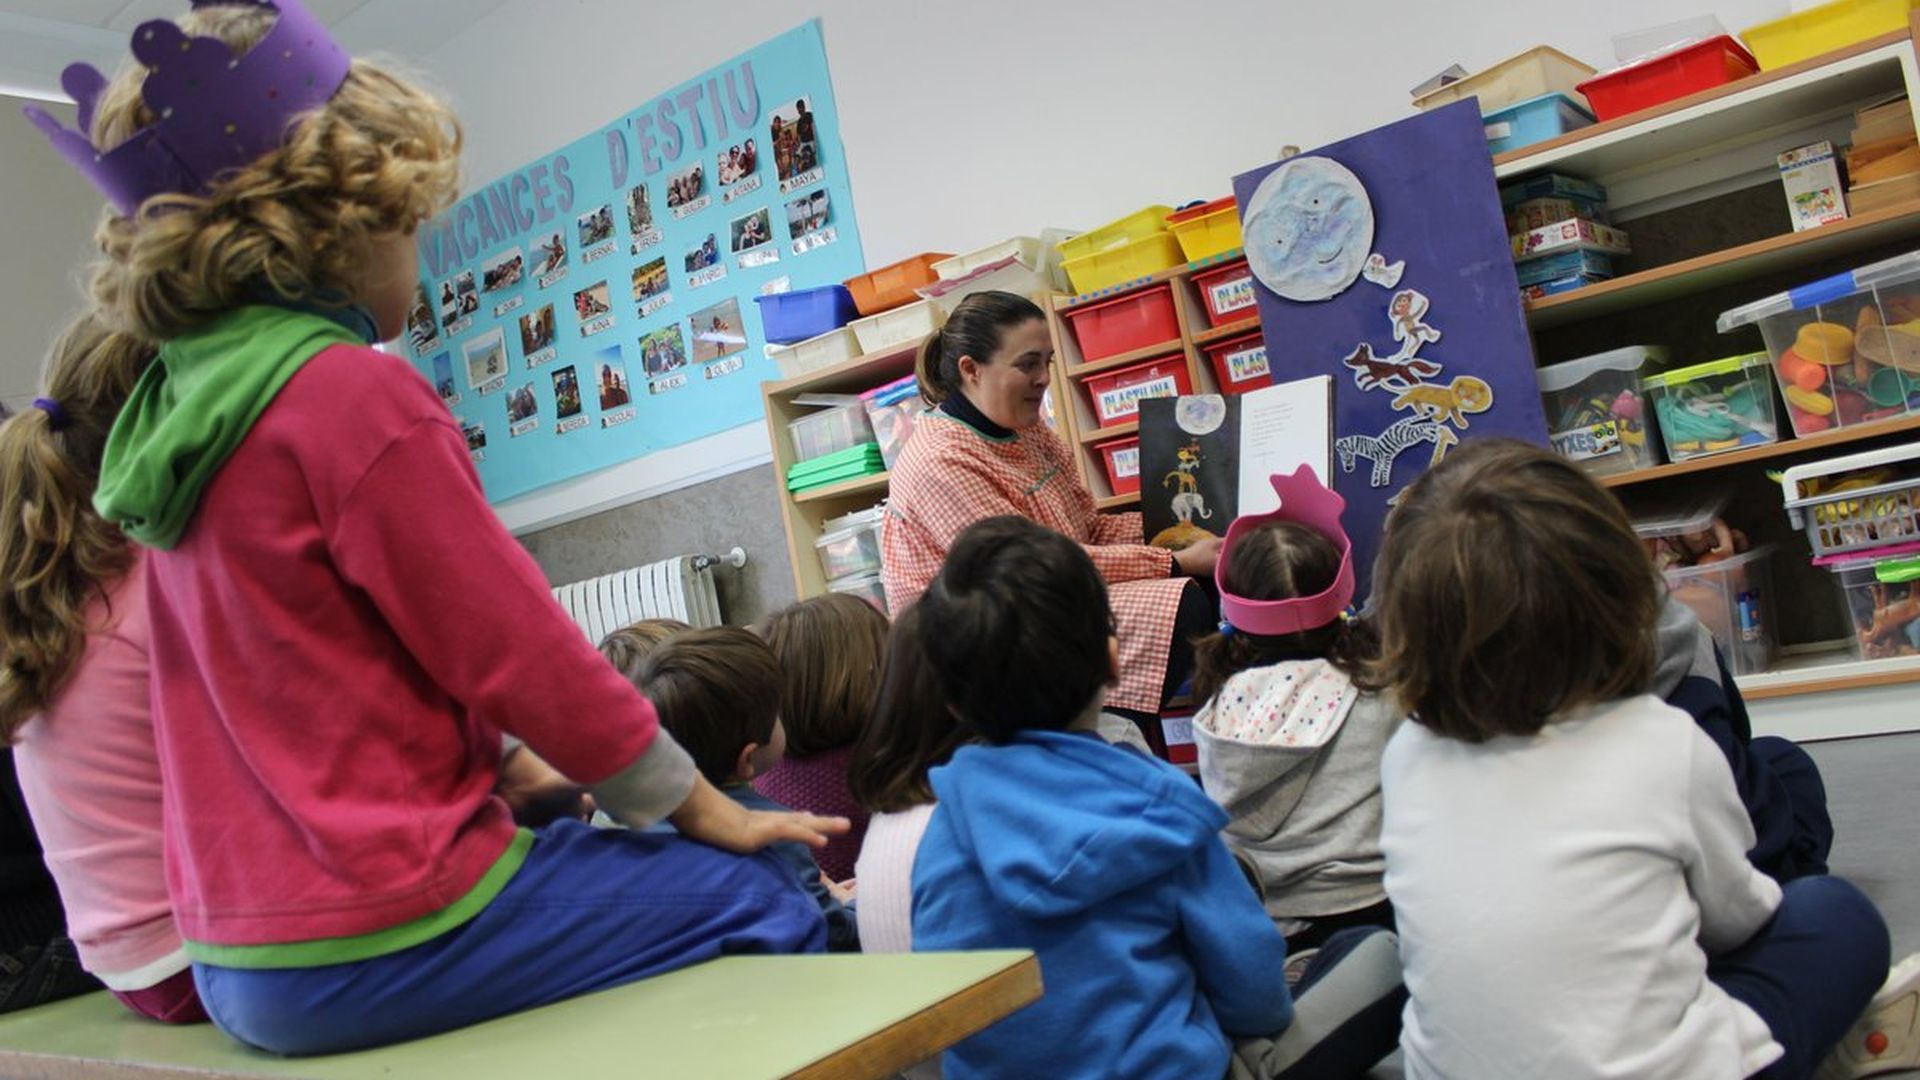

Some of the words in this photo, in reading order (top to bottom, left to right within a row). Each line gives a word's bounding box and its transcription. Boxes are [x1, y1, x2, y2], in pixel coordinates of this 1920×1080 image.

[422, 154, 576, 277] VACANCES
[605, 60, 761, 190] D'ESTIU
[789, 170, 818, 189] MAYA
